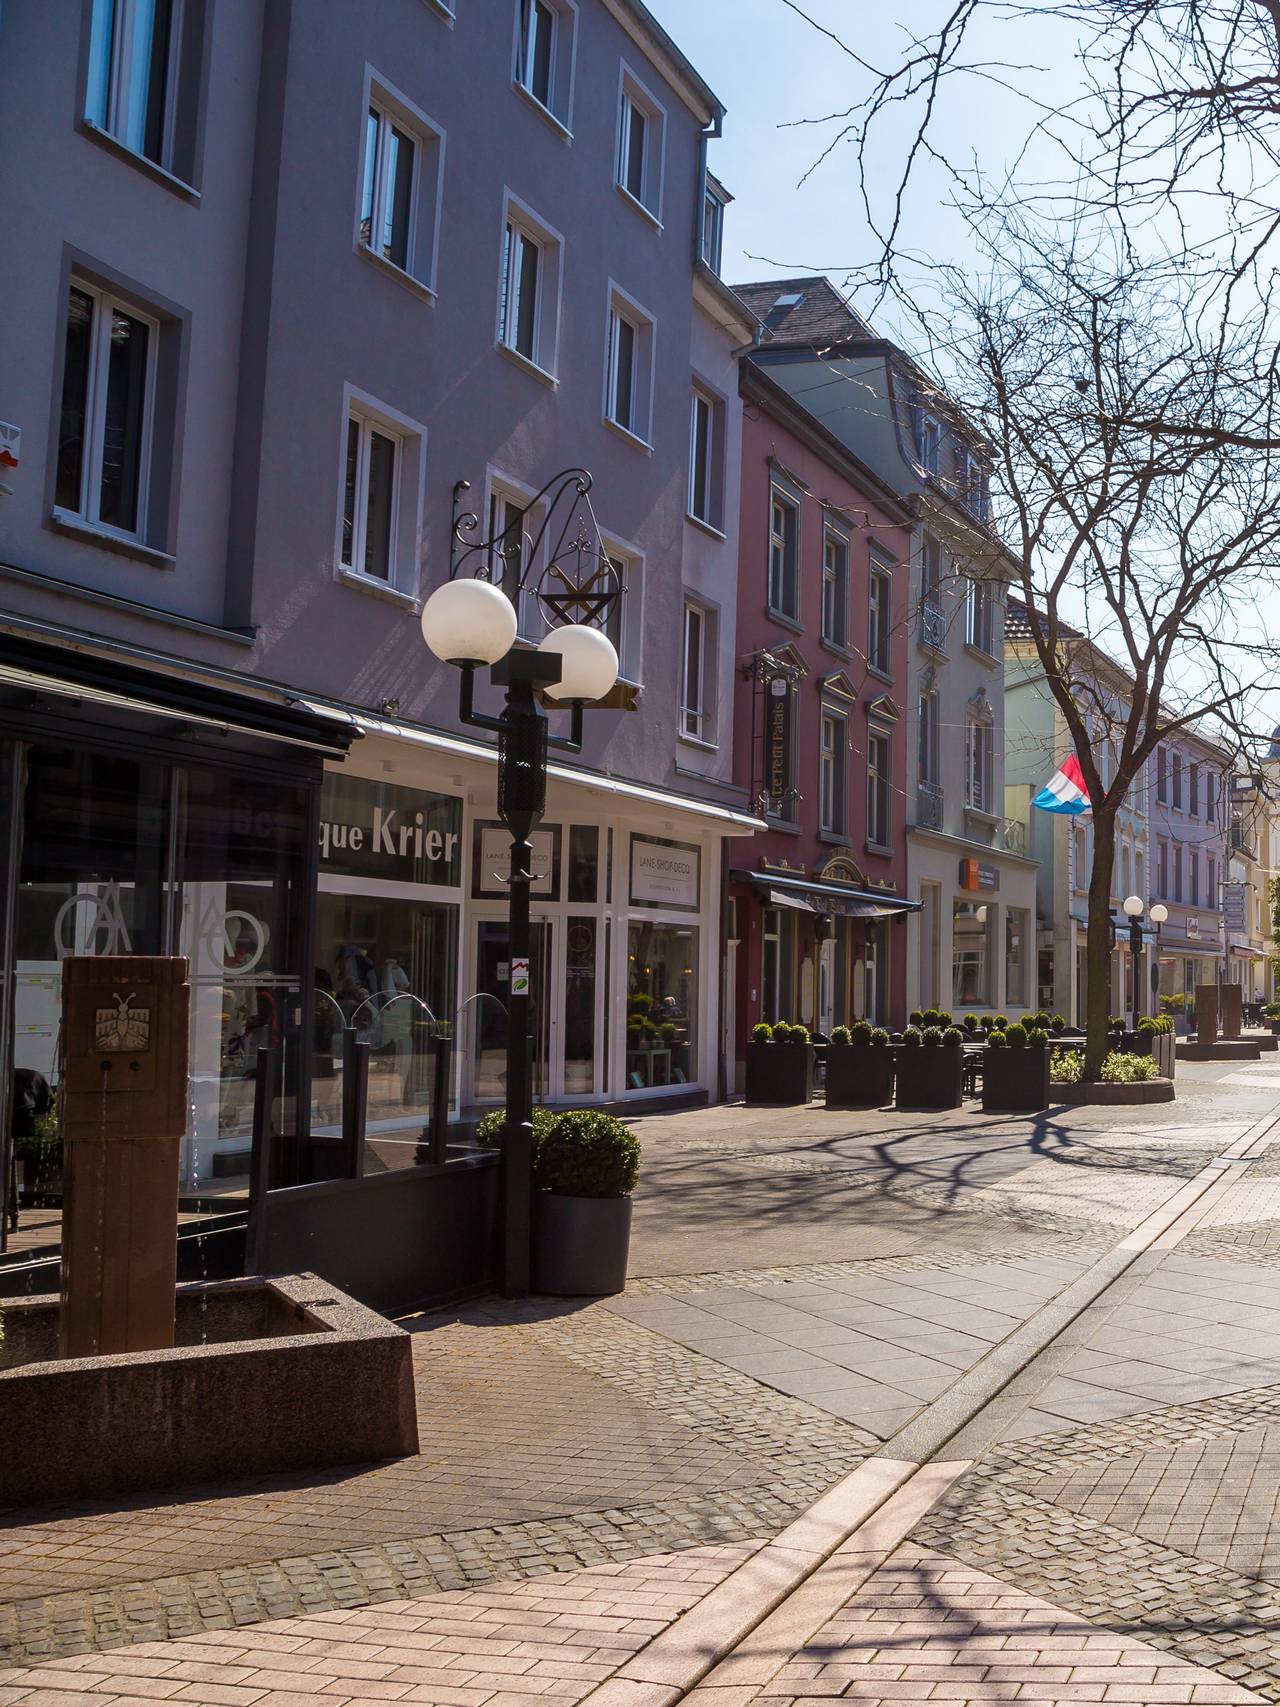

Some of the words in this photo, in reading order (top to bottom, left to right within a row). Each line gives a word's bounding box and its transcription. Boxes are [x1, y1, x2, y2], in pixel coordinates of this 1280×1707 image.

[772, 702, 784, 741] Palais
[772, 742, 784, 774] Petit
[772, 775, 783, 797] Le
[372, 808, 458, 863] Krier
